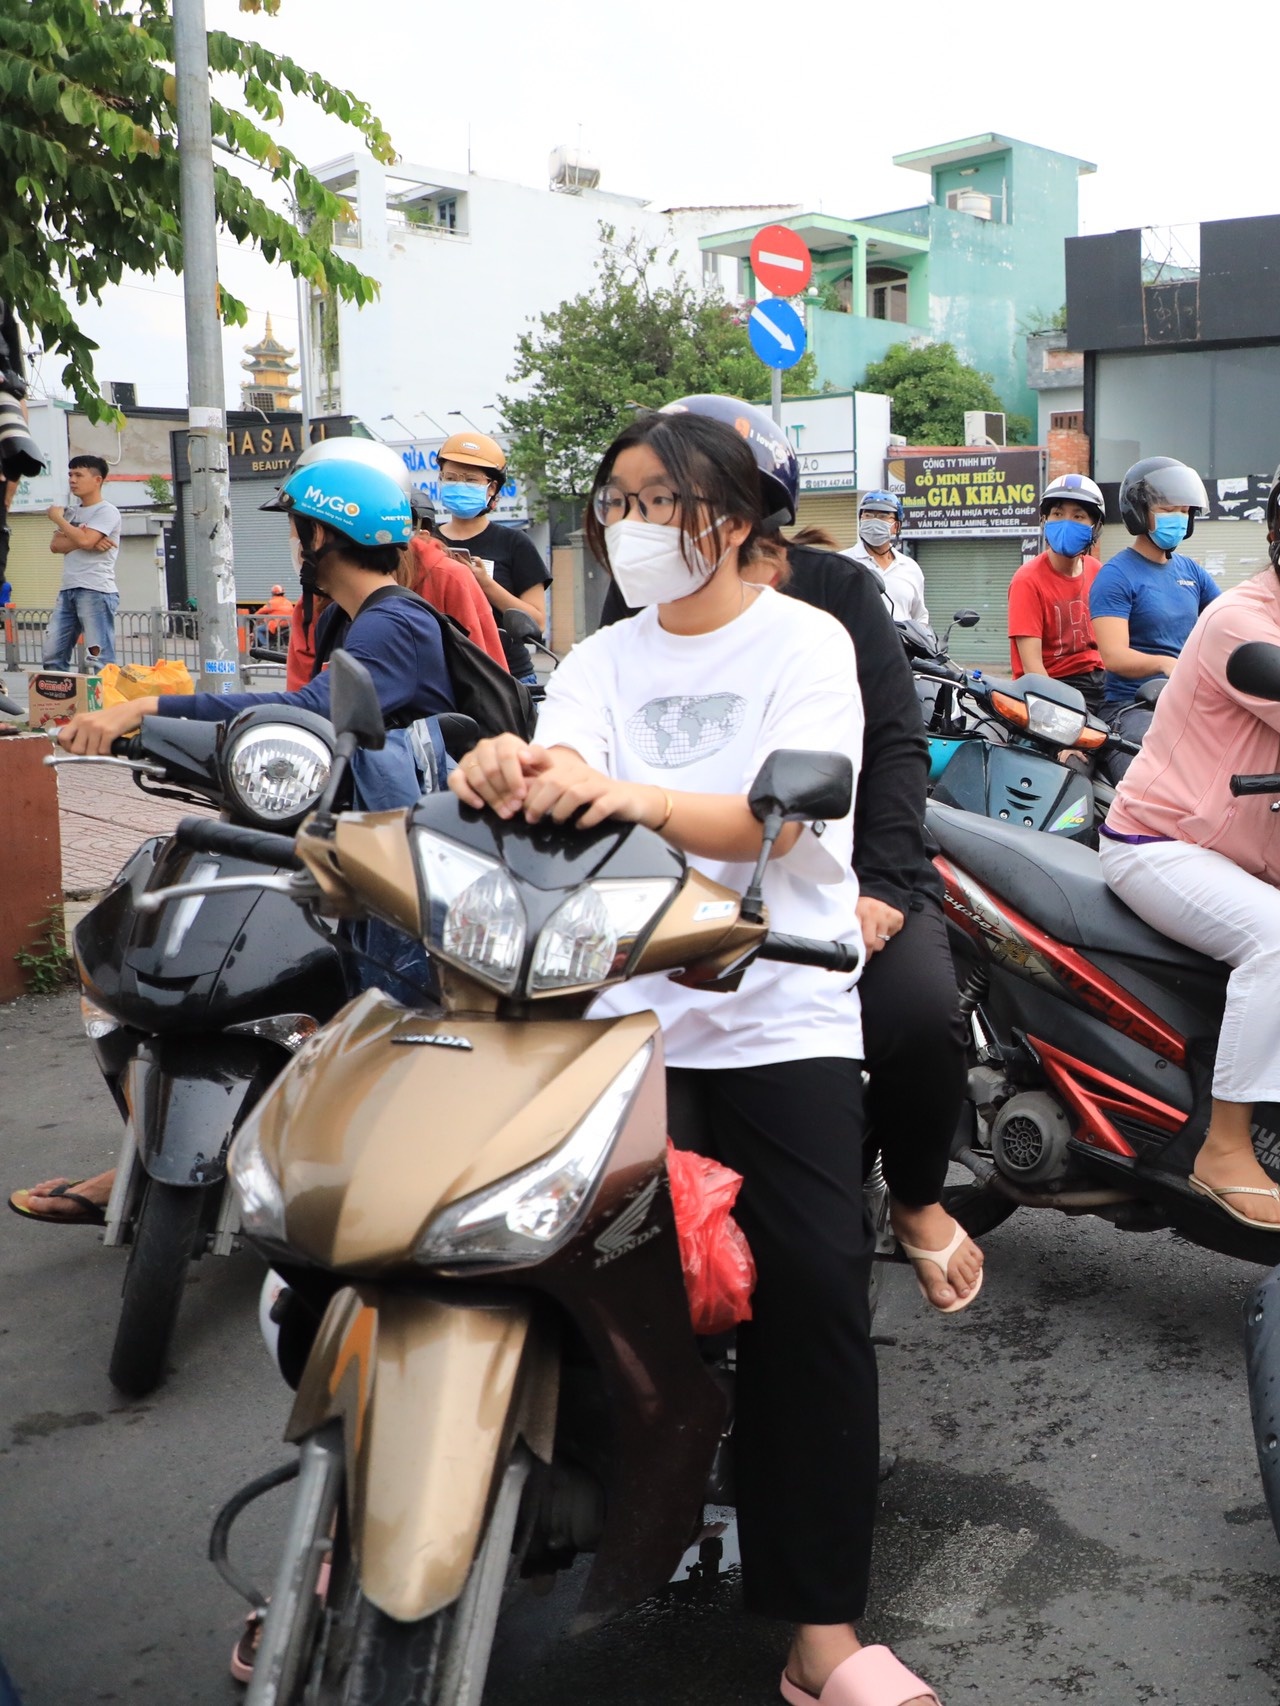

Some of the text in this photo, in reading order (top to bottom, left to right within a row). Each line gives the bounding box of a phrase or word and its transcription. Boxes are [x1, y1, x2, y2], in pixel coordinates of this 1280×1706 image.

[252, 460, 291, 472] BEAUTY
[922, 456, 997, 469] CÔNG TY TNHH MTV
[936, 472, 971, 486] MINH
[927, 486, 962, 507] GIA
[965, 484, 1036, 506] KHANG
[910, 510, 927, 519] MDF,
[928, 510, 945, 518] HDF,
[950, 519, 990, 528] MELAMINE,
[990, 518, 1020, 527] VENEER
[943, 890, 993, 929] ayate
[391, 1033, 473, 1049] HONDA
[594, 1225, 662, 1269] HONDA
